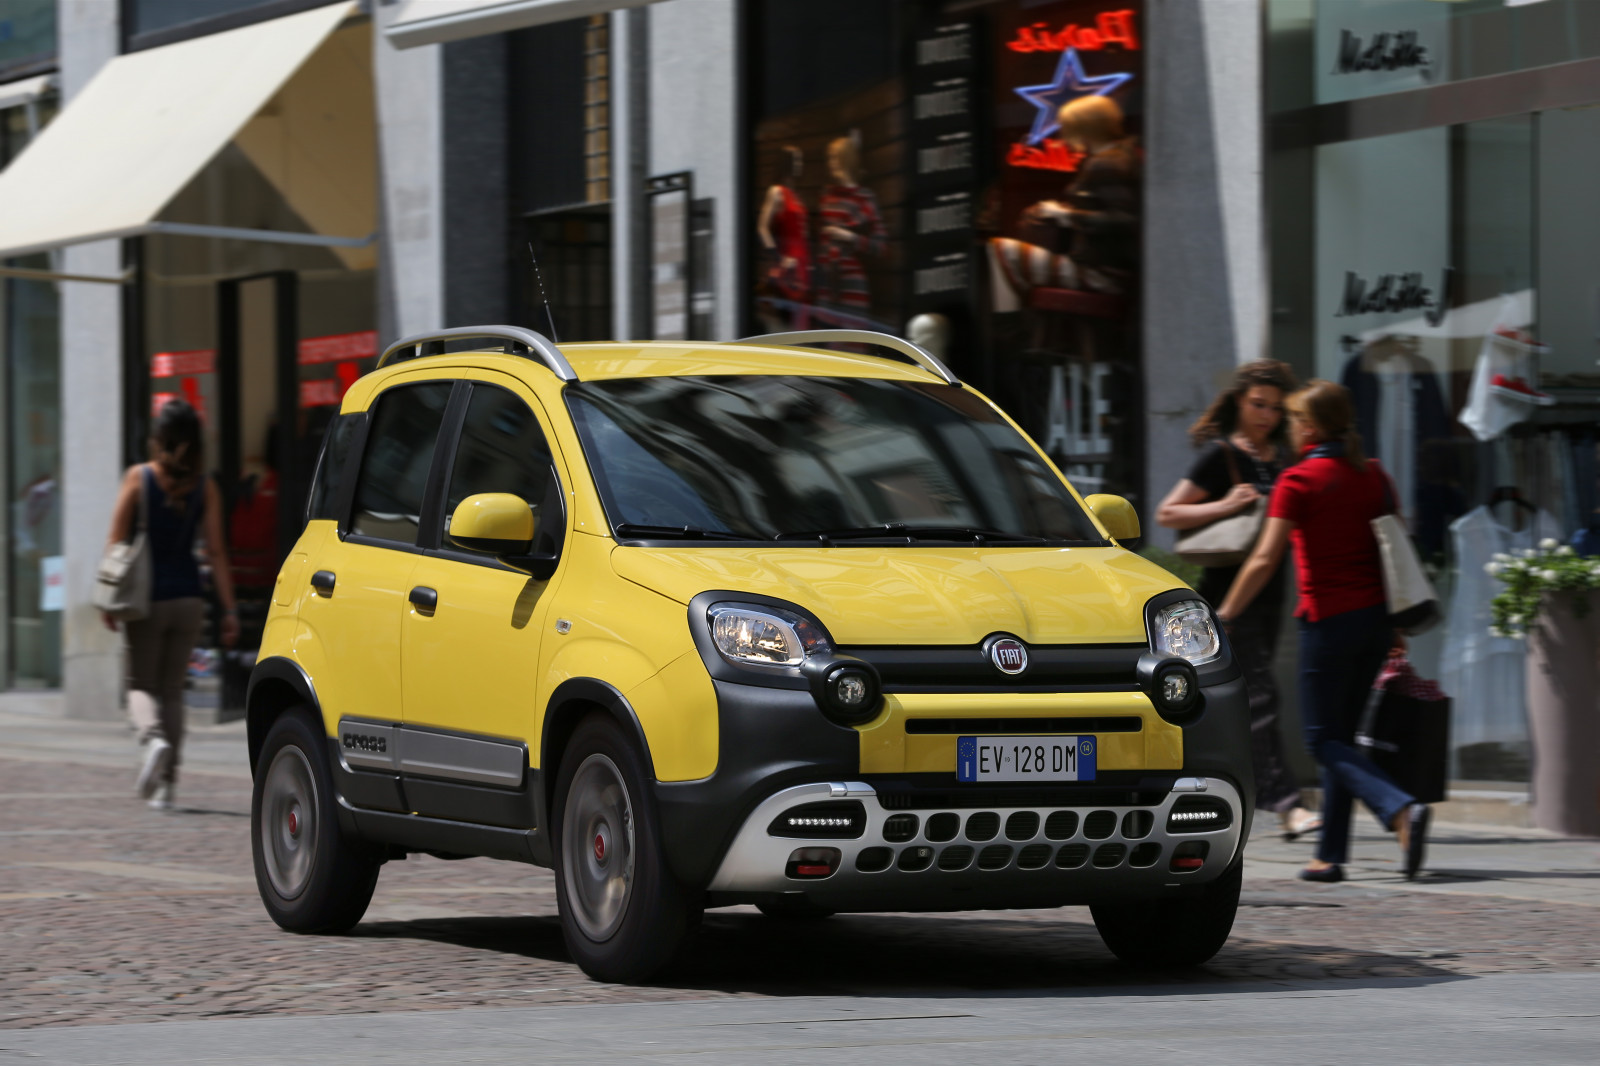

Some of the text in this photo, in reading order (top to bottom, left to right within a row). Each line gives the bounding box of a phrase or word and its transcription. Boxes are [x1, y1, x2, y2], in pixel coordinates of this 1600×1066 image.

[1000, 649, 1020, 665] FIAT
[343, 733, 386, 752] cross
[980, 745, 1076, 773] EV 128 DM
